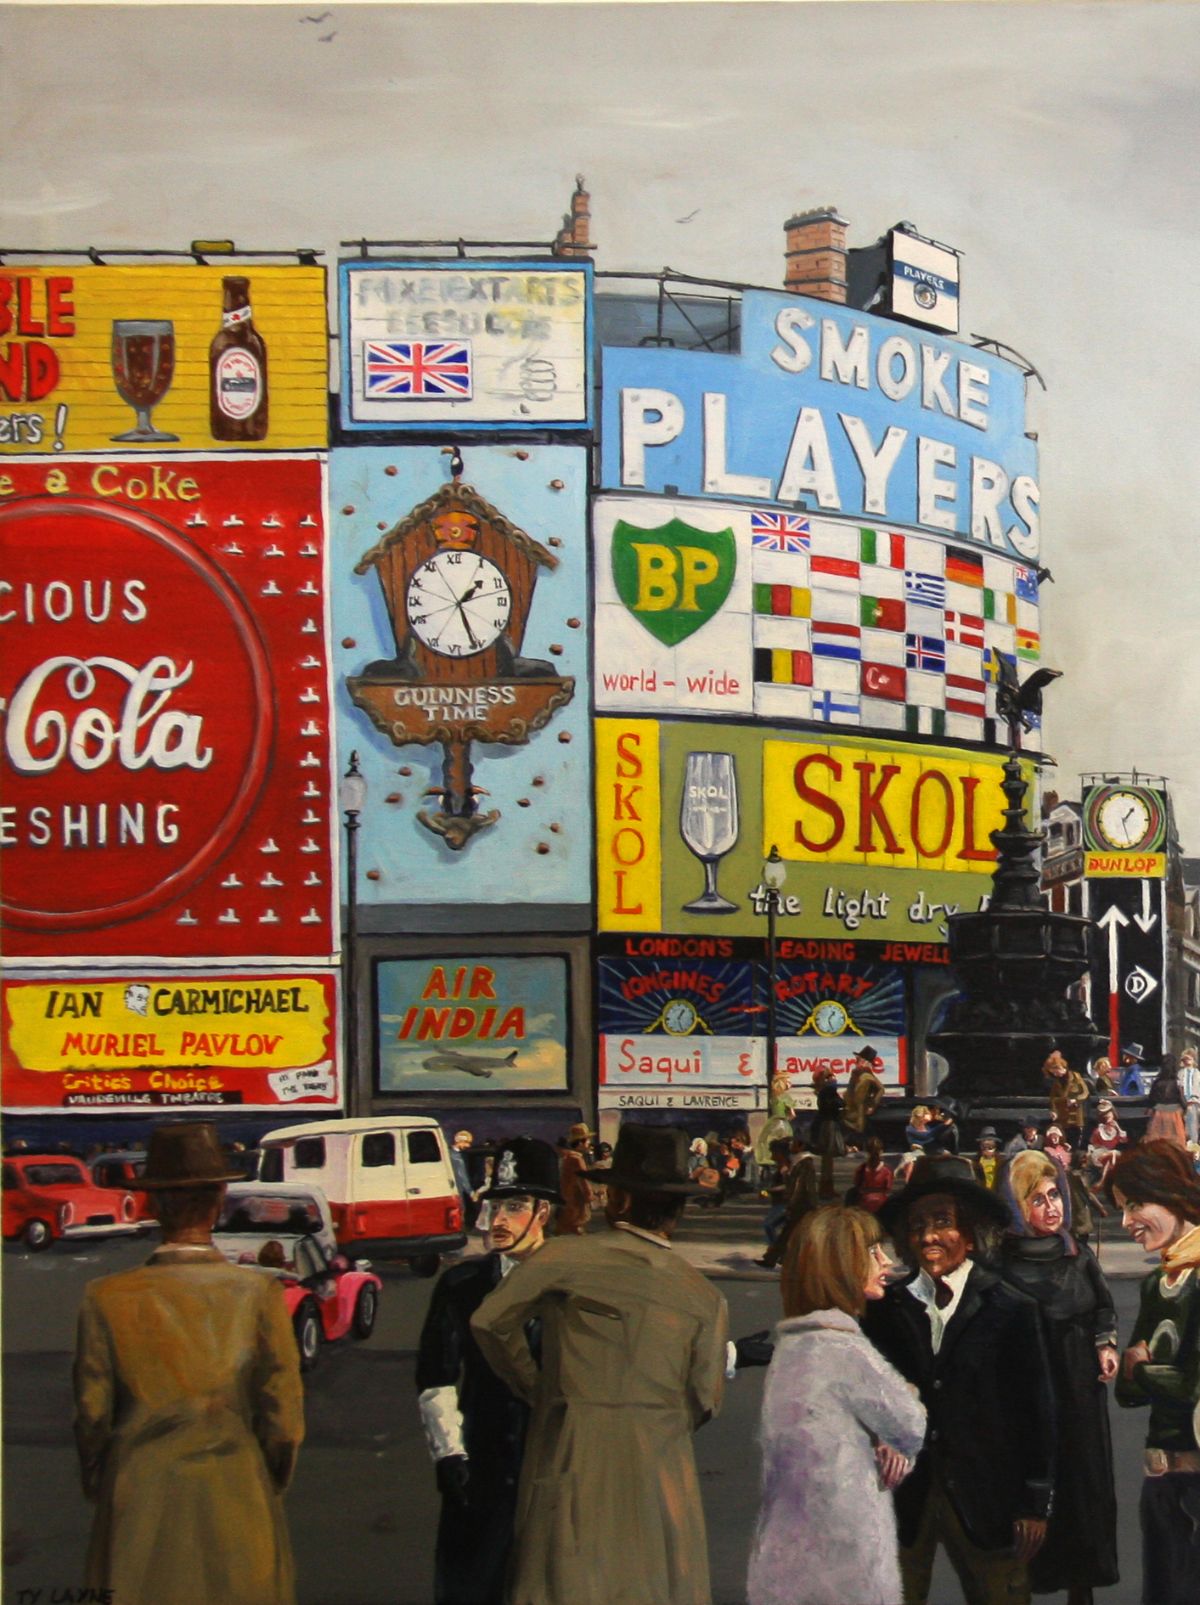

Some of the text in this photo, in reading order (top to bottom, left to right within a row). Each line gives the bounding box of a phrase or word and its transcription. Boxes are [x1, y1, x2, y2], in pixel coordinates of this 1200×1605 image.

[903, 265, 946, 291] PLAYERS
[768, 306, 991, 432] SMOKE
[45, 469, 70, 494] a
[91, 465, 201, 502] Coke
[619, 386, 1040, 560] PLAYERS
[629, 541, 720, 613] BP
[394, 686, 519, 706] GUINNESS
[602, 670, 657, 694] world
[687, 668, 740, 696] wide
[6, 655, 213, 772] Cola
[423, 704, 491, 722] TIME
[688, 785, 729, 801] SKOL
[793, 752, 1000, 862] SKOL
[0, 801, 180, 847] ESHING
[610, 732, 647, 915] SKOL
[1088, 857, 1158, 873] DUNLOP
[823, 887, 890, 929] light
[625, 938, 734, 957] LONDON'S
[421, 965, 498, 1000] AIR
[774, 970, 876, 1003] ROTARY
[1130, 970, 1146, 994] D
[44, 986, 310, 1019] IAN CARMICHAEL
[397, 1006, 528, 1041] INDIA
[60, 1031, 285, 1058] MURIEL PAVLOV
[618, 1038, 703, 1084] Saqui
[774, 1042, 886, 1075] Lawrene
[148, 1070, 225, 1092] Choice
[618, 1095, 660, 1108] SAQUI
